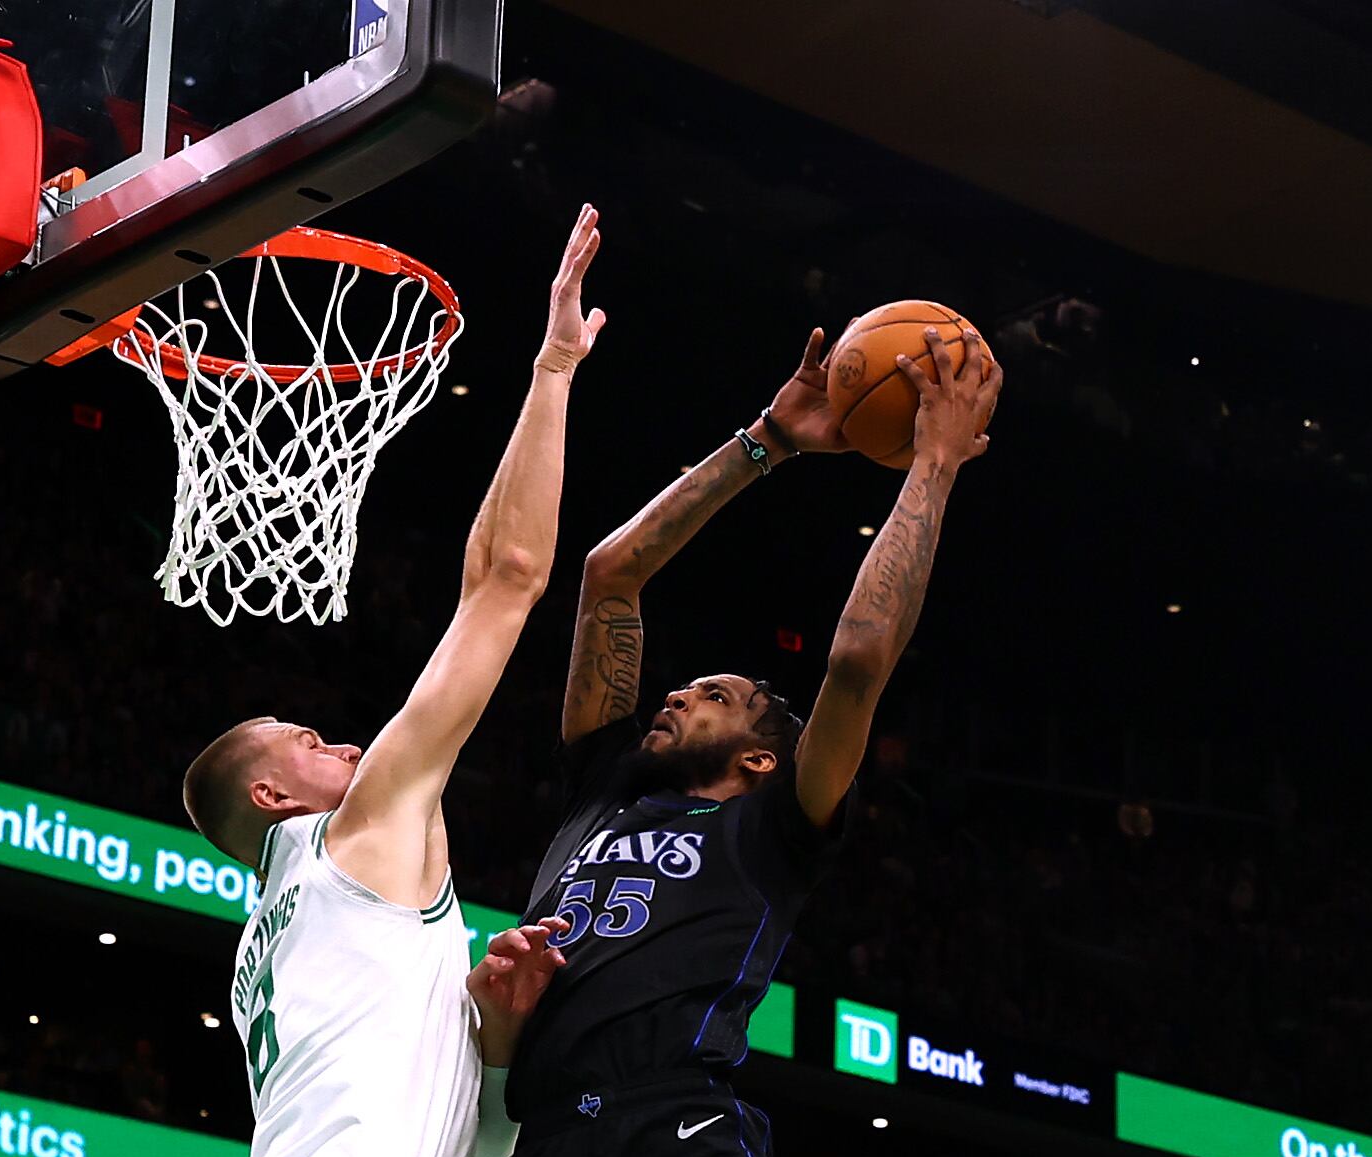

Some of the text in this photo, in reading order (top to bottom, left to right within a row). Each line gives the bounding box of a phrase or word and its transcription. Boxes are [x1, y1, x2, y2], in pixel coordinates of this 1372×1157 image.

[560, 828, 704, 880] MAVS
[545, 876, 656, 949] 55
[840, 1013, 891, 1066] TD
[908, 1035, 984, 1086] Bank
